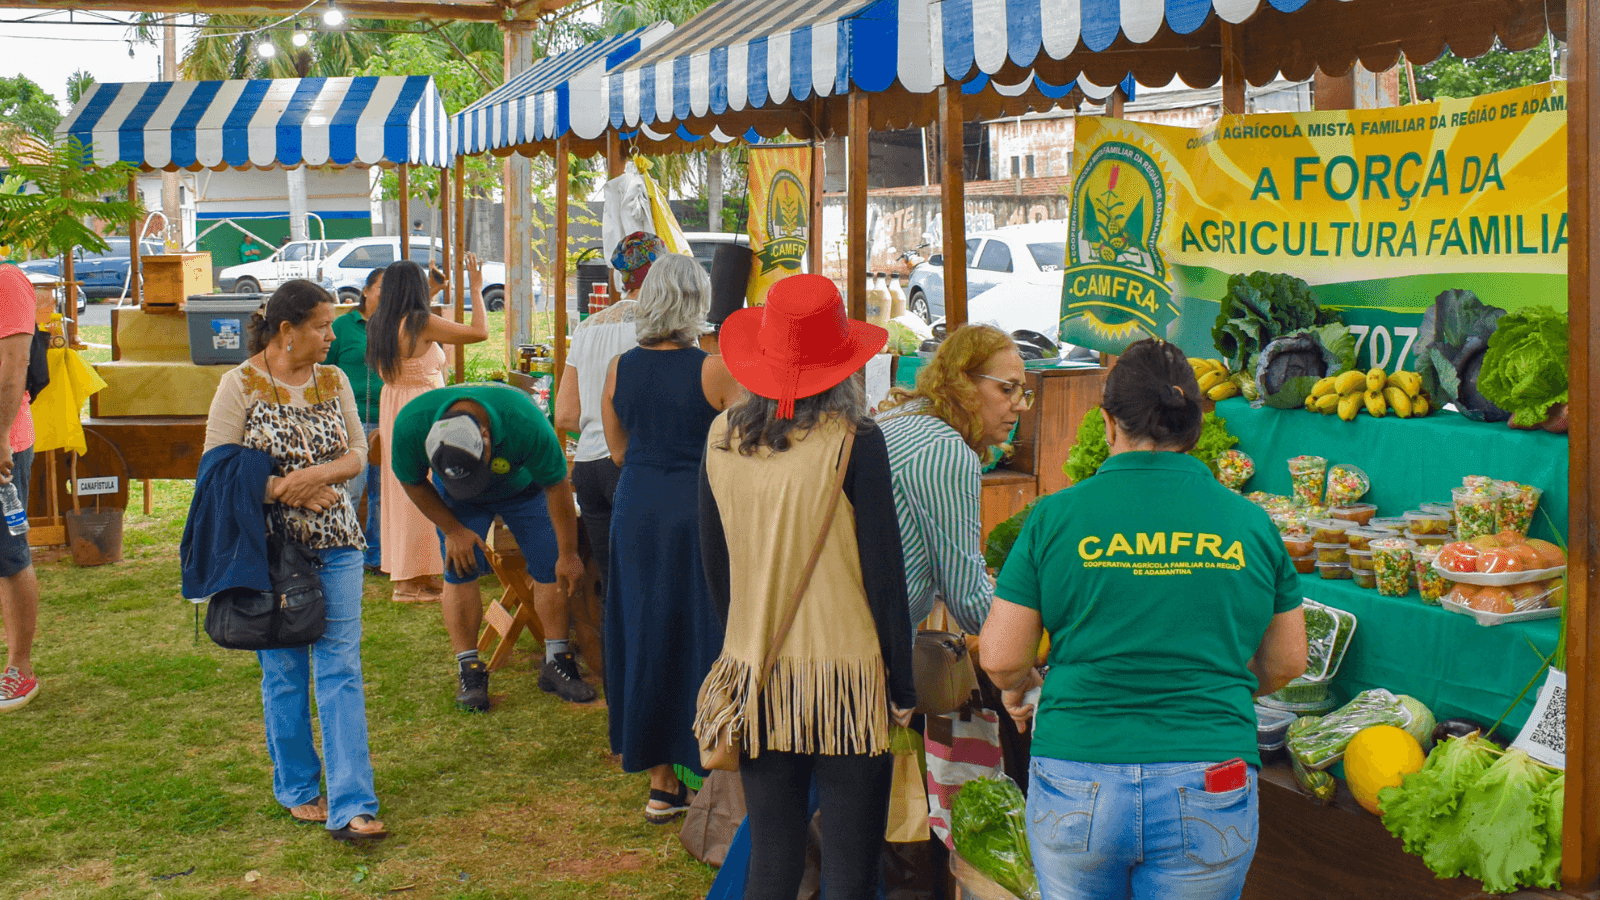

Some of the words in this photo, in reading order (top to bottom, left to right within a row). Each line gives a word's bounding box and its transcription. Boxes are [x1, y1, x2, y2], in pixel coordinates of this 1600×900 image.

[1223, 122, 1303, 139] AGRÍCOLA
[1307, 122, 1356, 137] MISTA
[1361, 117, 1425, 135] FAMILIAR
[1429, 115, 1447, 130] DA
[1451, 104, 1497, 127] REGIÃO
[1500, 103, 1518, 119] DE
[1521, 95, 1568, 116] ADAM
[1103, 146, 1134, 160] FAMILIAR
[1133, 154, 1144, 164] DA
[1142, 161, 1161, 188] REGIÃO
[1155, 188, 1163, 200] DE
[1250, 167, 1280, 201] A
[1294, 149, 1449, 211] FORÇA
[1460, 152, 1505, 194] DA
[1181, 220, 1417, 257] AGRICULTURA
[1073, 274, 1156, 313] CAMFRA
[80, 480, 115, 491] CANAFÍSTULA
[1078, 532, 1246, 567] CAMFRA
[1083, 560, 1131, 568] COOPERATIVA
[1132, 561, 1169, 569] AGRÍCOLA
[1216, 562, 1241, 571] REGIÃO
